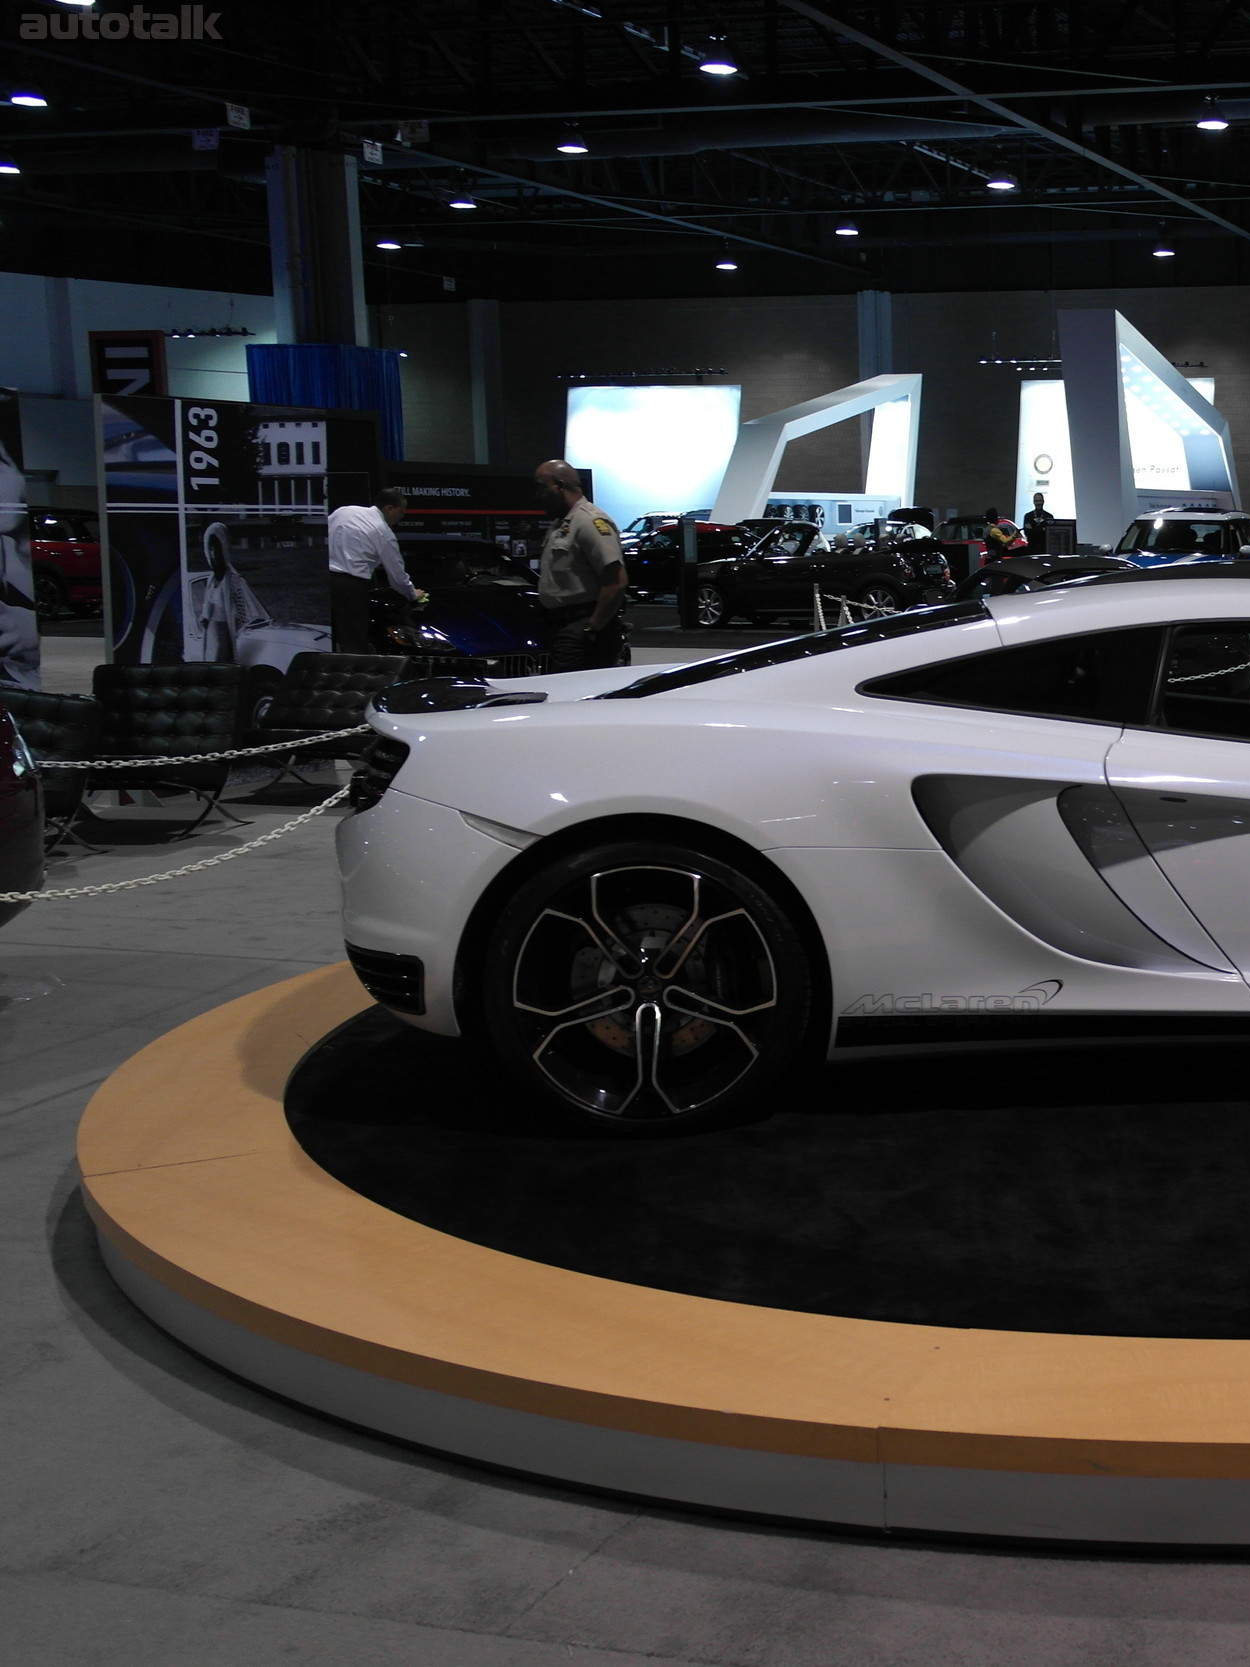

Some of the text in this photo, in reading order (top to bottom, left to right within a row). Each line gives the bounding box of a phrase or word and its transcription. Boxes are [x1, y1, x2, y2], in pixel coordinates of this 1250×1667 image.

[188, 406, 221, 493] 1963
[412, 487, 440, 496] MAKING
[441, 487, 471, 497] HISTORY.
[841, 993, 1041, 1014] McLaren
